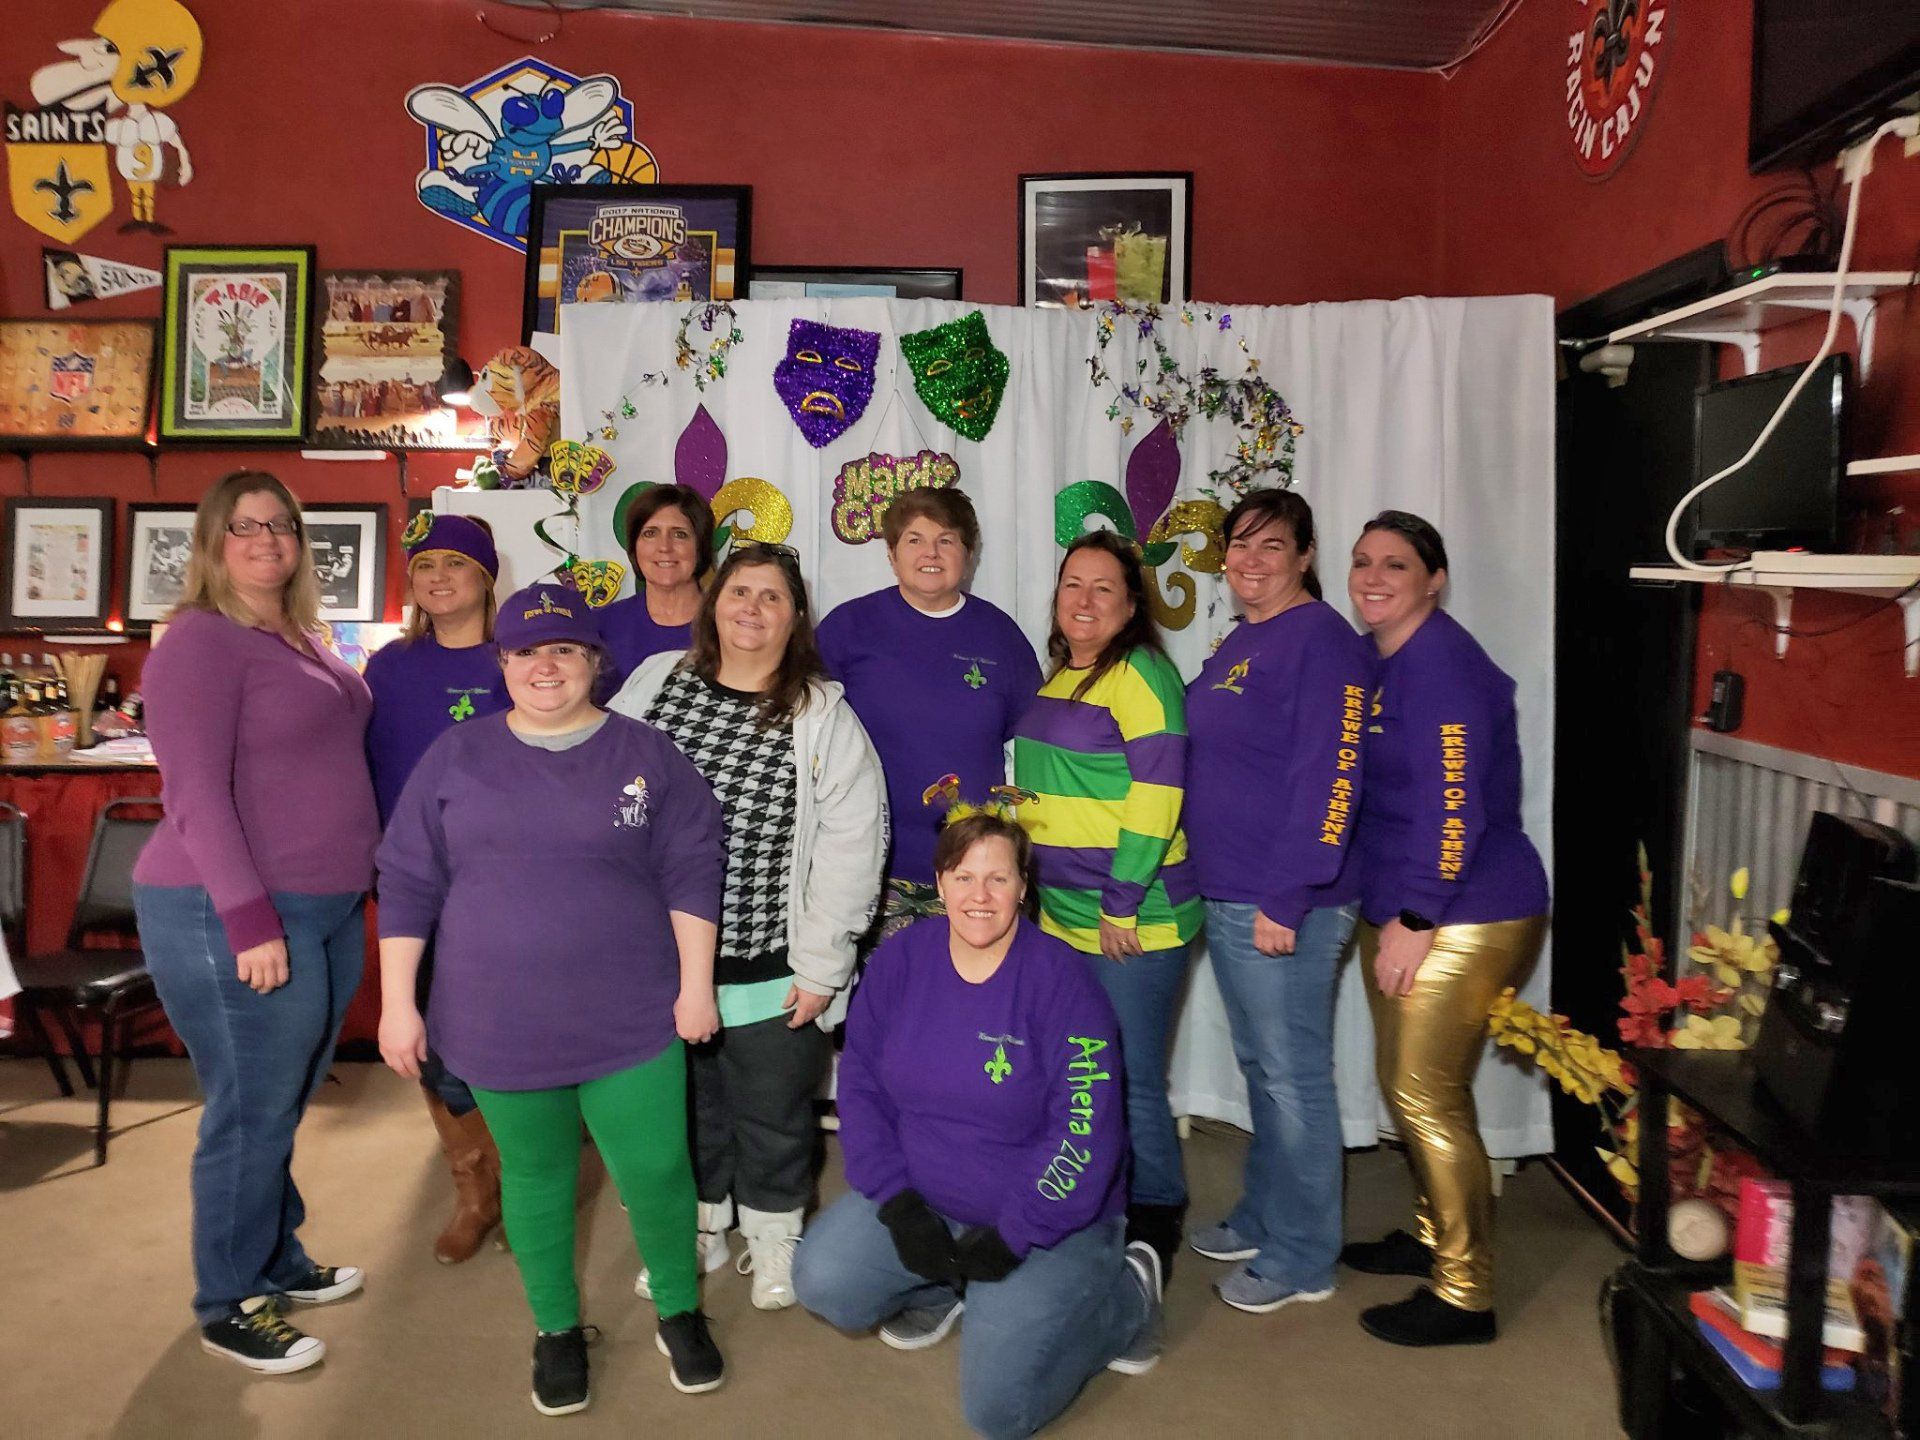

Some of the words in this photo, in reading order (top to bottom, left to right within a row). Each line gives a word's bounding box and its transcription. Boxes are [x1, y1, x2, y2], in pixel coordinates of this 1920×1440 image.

[1601, 0, 1665, 160] CAJUN
[6, 111, 106, 142] SAINTS
[591, 217, 685, 245] CHAMPIONS
[602, 208, 628, 216] 2007
[631, 208, 678, 216] NATIONAL
[836, 500, 891, 540] Gr
[1340, 684, 1366, 745] KREWE
[1336, 748, 1358, 771] OF
[1439, 724, 1468, 782] KREWE
[1319, 778, 1354, 846] ATHENA
[1443, 787, 1466, 810] OF
[1067, 1036, 1111, 1136] Athena
[1037, 1139, 1092, 1201] 2020
